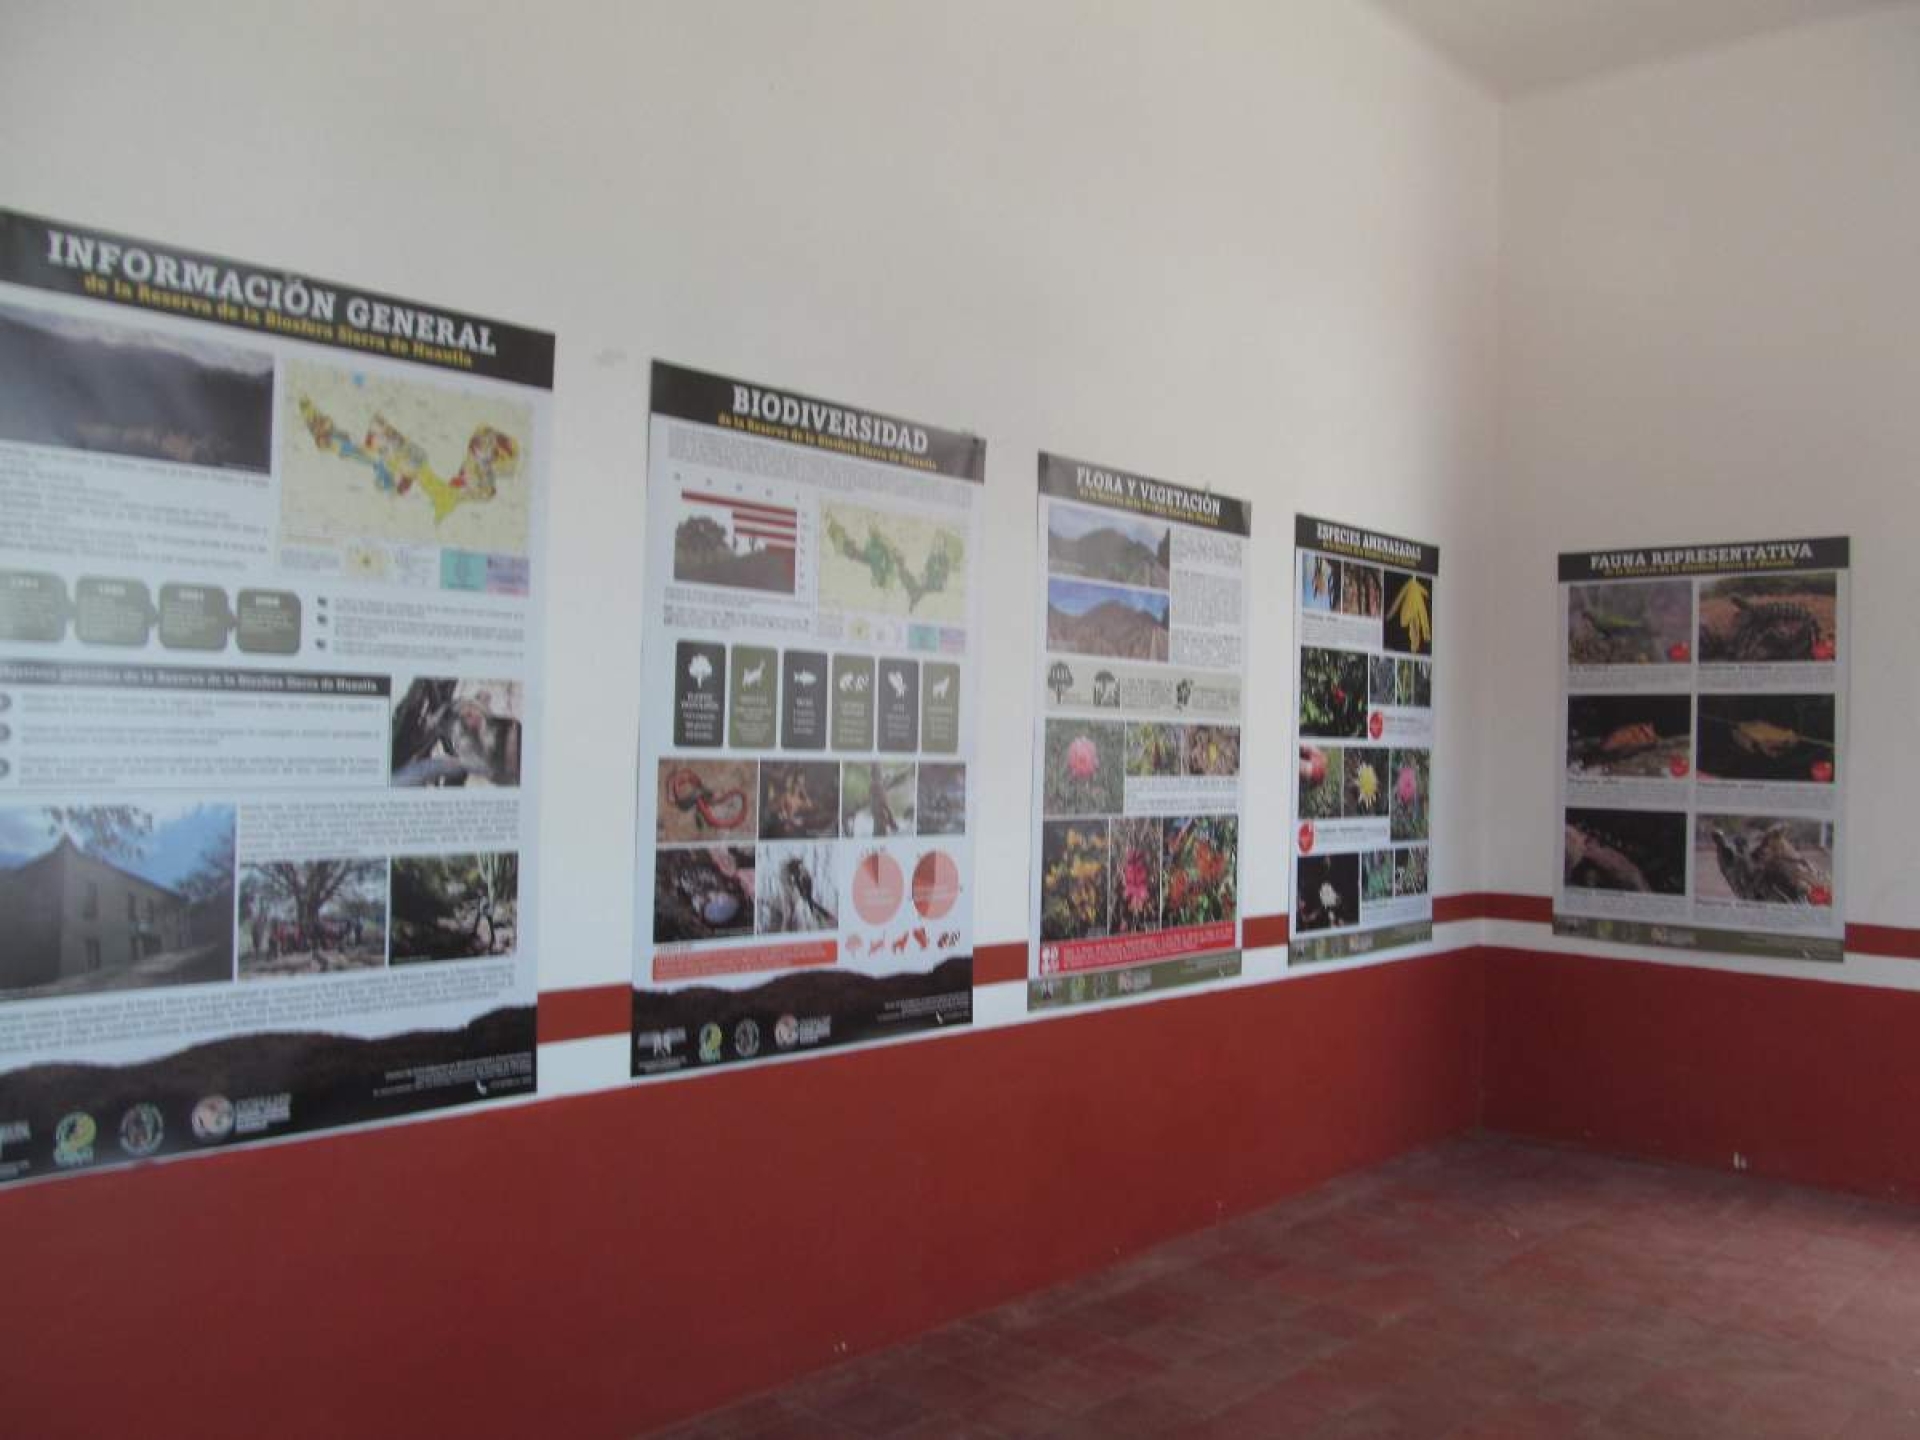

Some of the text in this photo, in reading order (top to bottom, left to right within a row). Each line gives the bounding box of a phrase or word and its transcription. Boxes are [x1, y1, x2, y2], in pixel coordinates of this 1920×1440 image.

[47, 229, 497, 356] INFORMACIÓN GENERAL
[731, 384, 929, 453] BIODIVERSIDAD
[1076, 466, 1123, 495] FLORA
[1126, 477, 1138, 497] Y
[1140, 481, 1221, 518] VEGETACIÓN
[1590, 552, 1646, 571] FAUNA
[1652, 542, 1814, 566] REPRESENTATIVA
